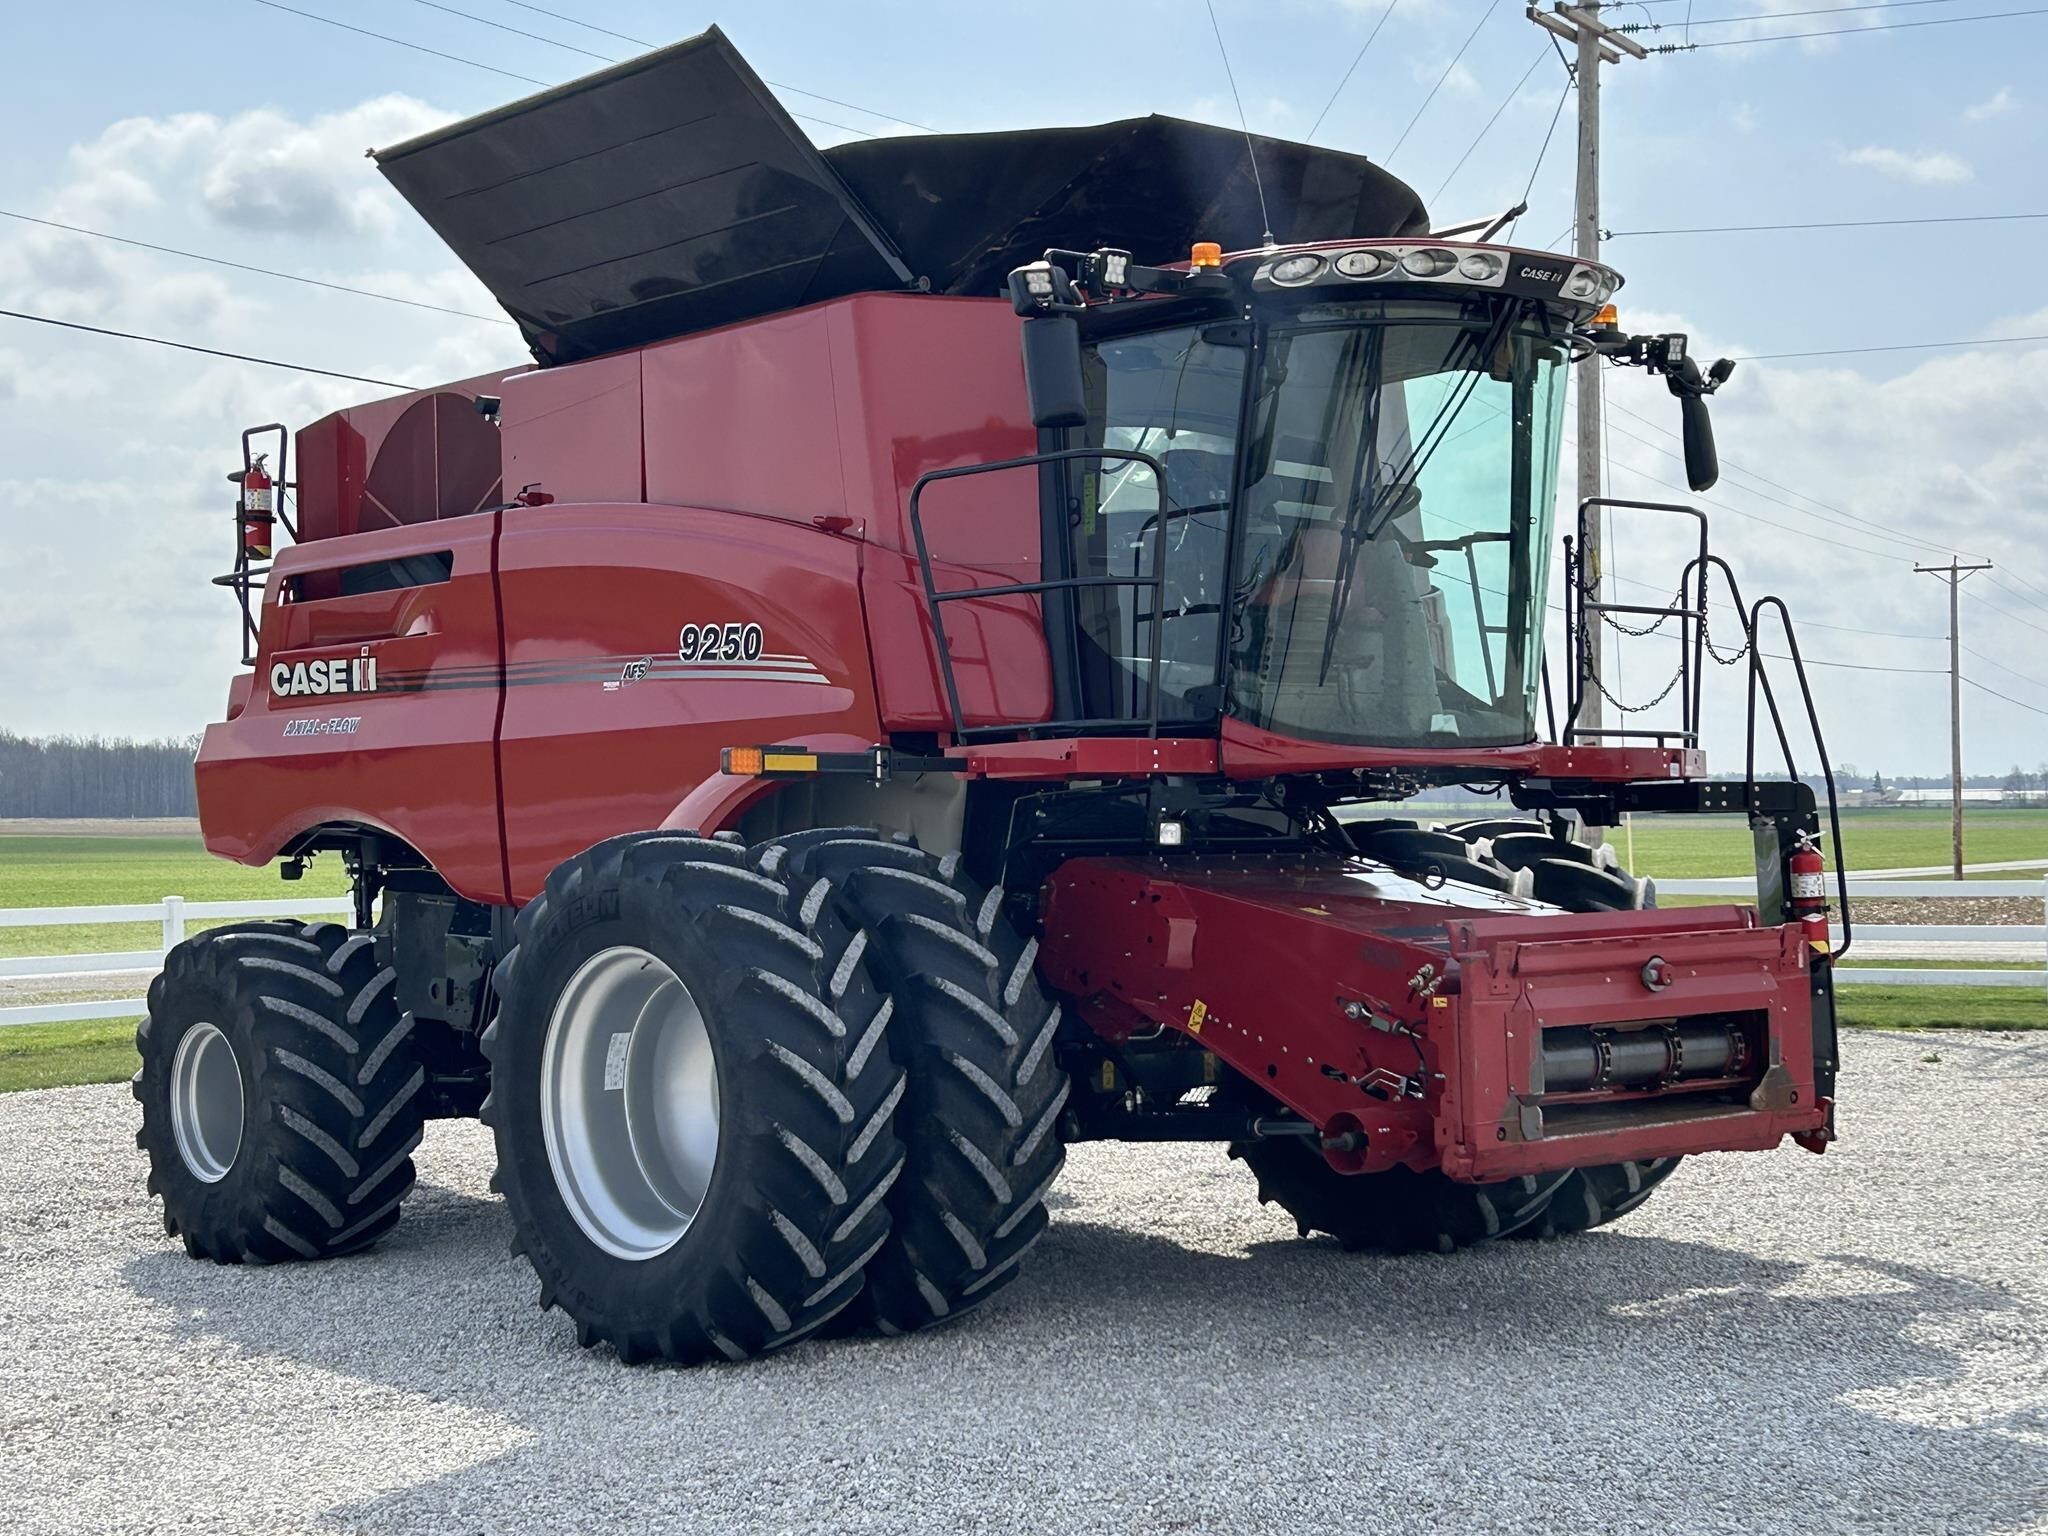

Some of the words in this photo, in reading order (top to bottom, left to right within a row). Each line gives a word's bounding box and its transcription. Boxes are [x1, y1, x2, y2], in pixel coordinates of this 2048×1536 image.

[1521, 267, 1551, 281] CASE
[679, 623, 764, 662] 9250
[271, 660, 348, 696] CASE
[621, 662, 648, 681] AFS
[283, 717, 361, 736] AXIAL-FLOW
